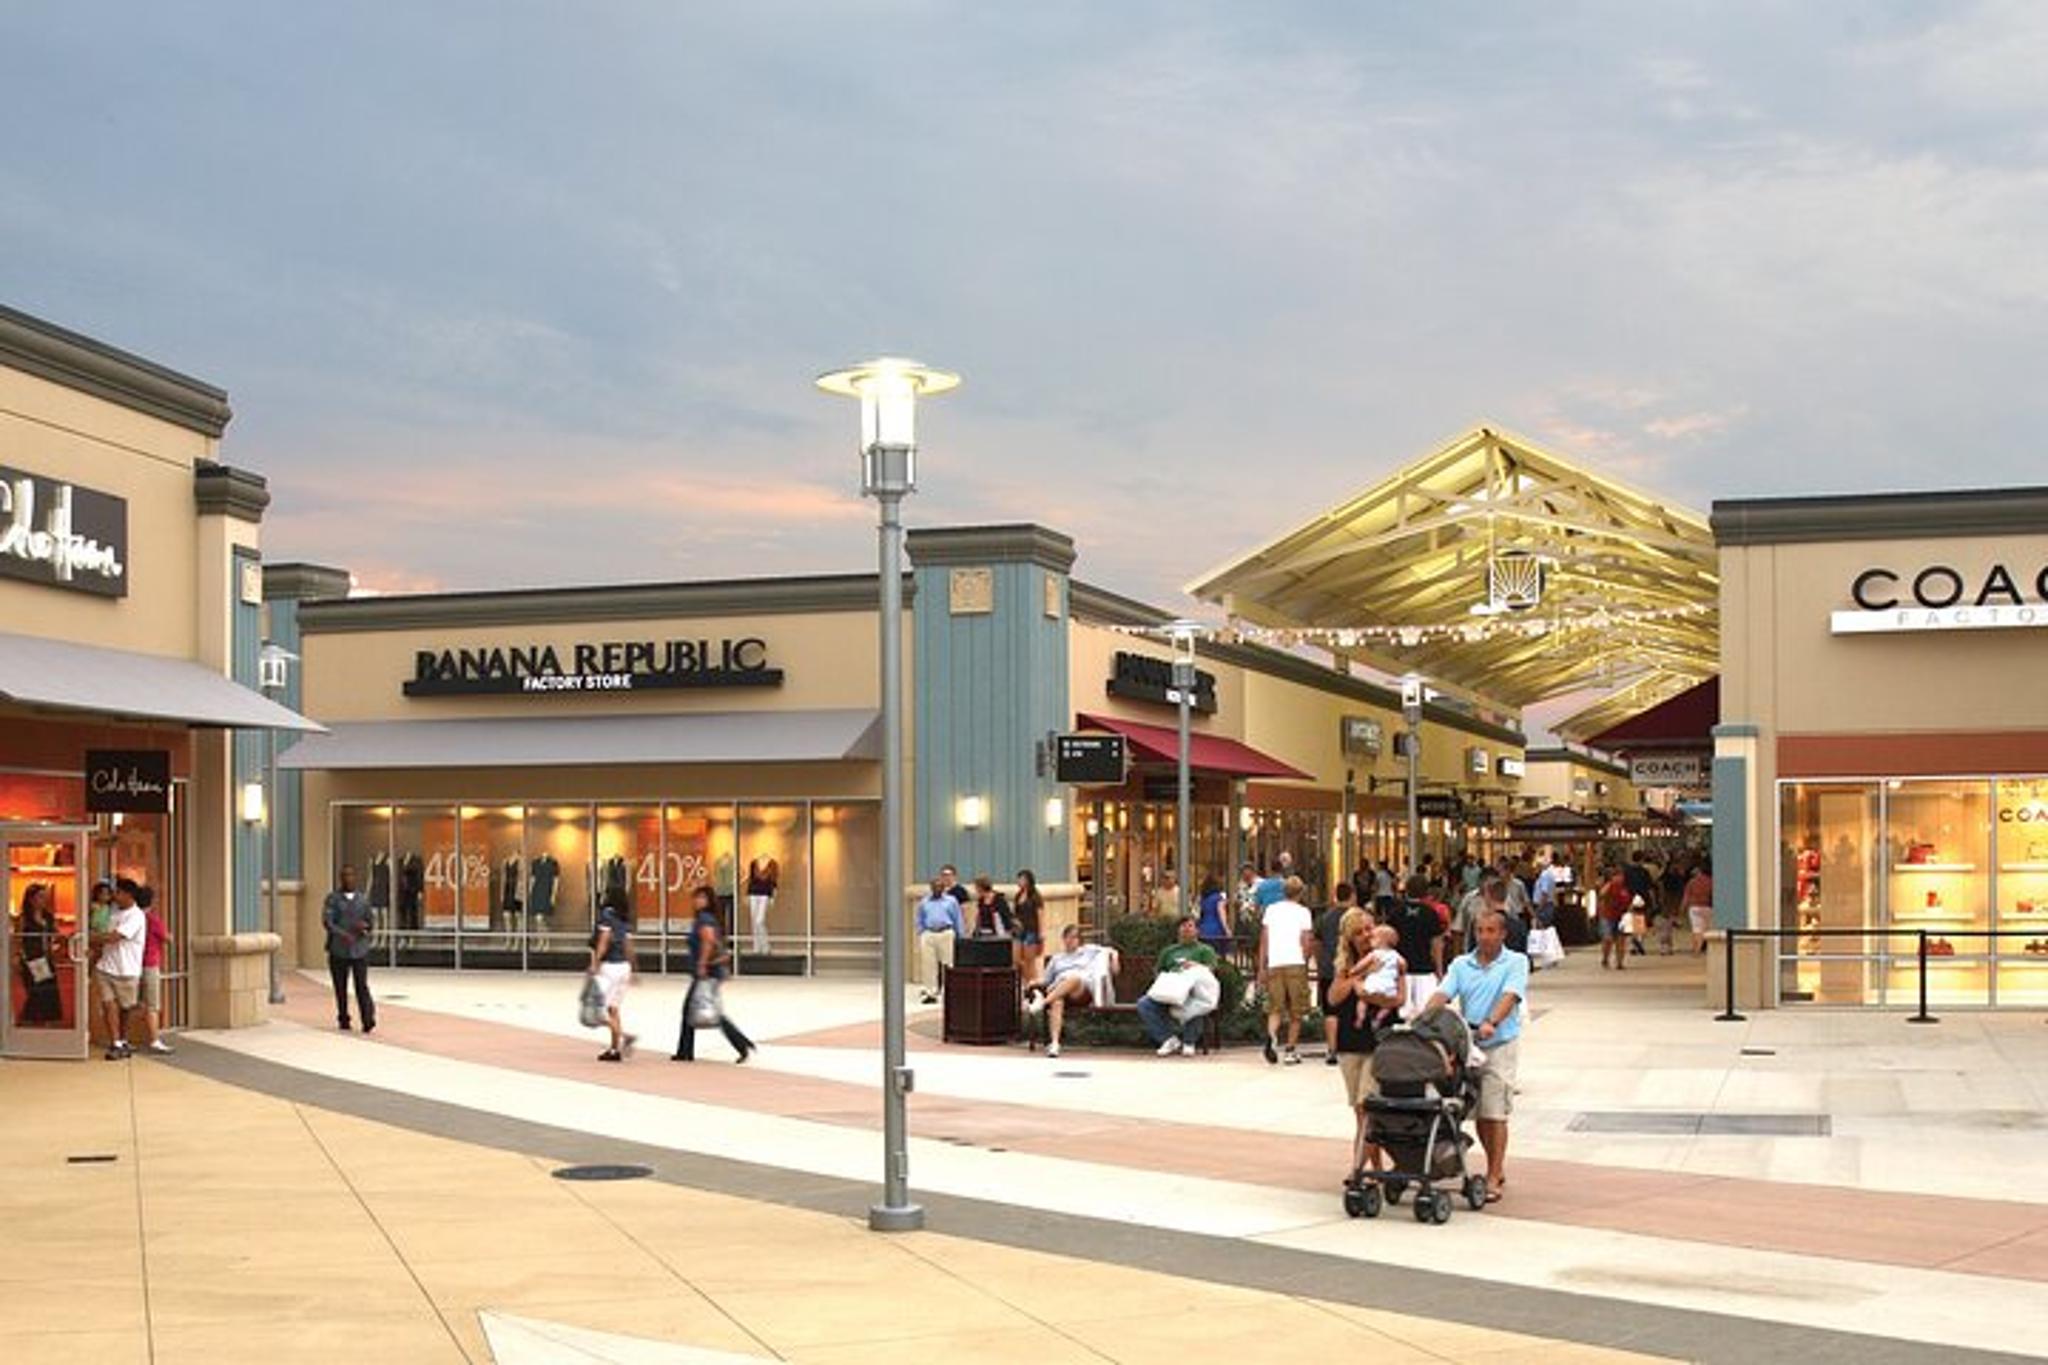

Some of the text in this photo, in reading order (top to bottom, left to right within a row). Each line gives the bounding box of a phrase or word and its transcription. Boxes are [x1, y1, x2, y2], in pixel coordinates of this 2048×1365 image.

[1852, 565, 2048, 611] COA
[416, 638, 767, 680] BANANA REPUBLIC
[523, 673, 632, 691] FACTORY STORE
[1635, 761, 1696, 774] COACH
[424, 852, 490, 891] 40%
[636, 852, 709, 892] 40%
